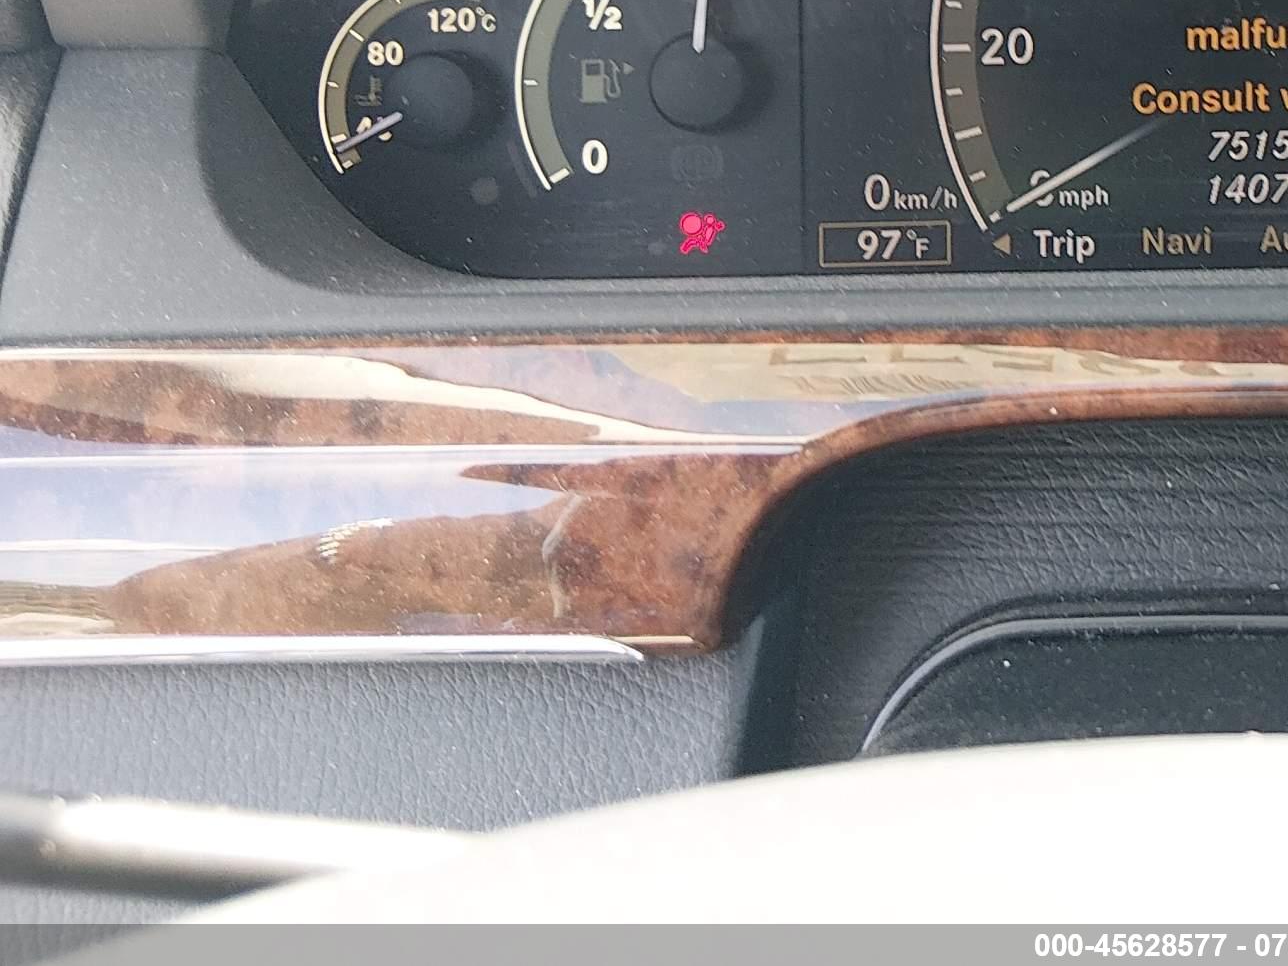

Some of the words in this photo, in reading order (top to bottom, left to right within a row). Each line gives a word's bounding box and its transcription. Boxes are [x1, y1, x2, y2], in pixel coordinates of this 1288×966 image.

[367, 40, 404, 66] 80
[981, 27, 1034, 65] 20
[1132, 81, 1270, 115] Consult
[581, 139, 608, 174] 0
[864, 173, 891, 211] 0
[894, 185, 958, 210] km/h
[1055, 181, 1109, 211] mph
[1033, 228, 1095, 264] Trip
[1142, 226, 1212, 255] Navi
